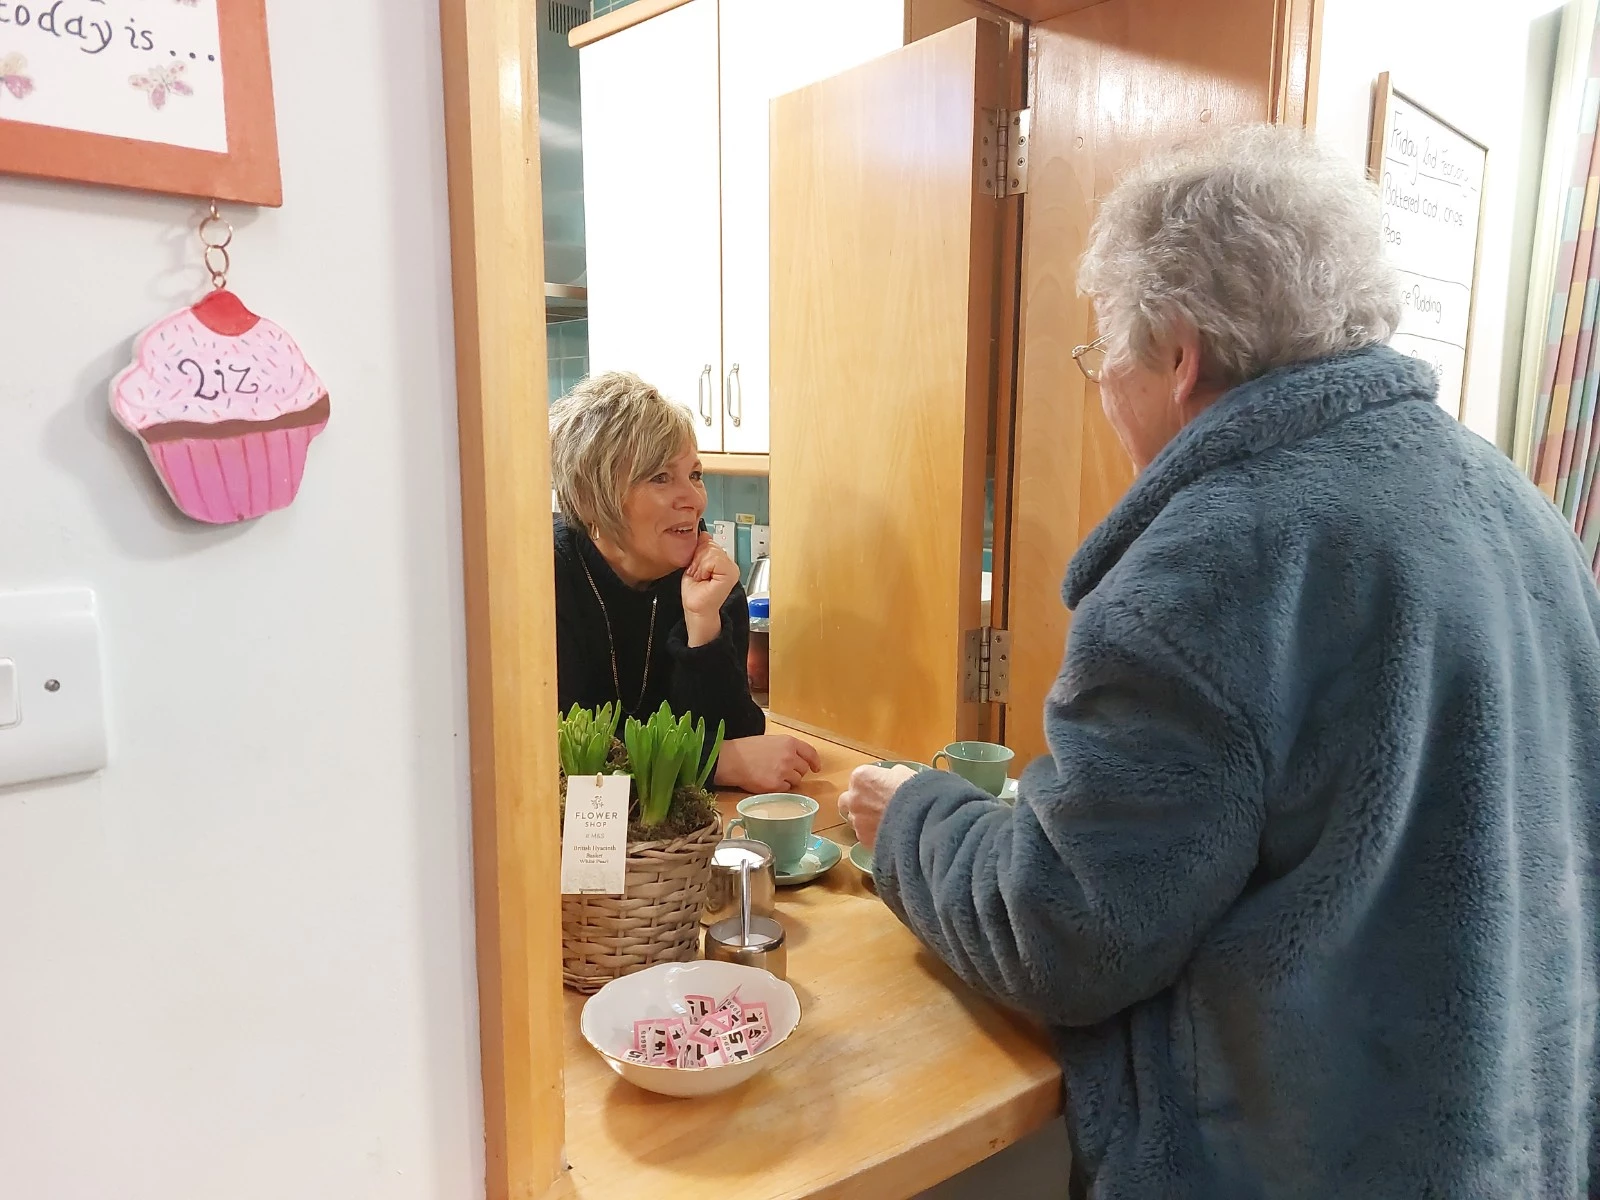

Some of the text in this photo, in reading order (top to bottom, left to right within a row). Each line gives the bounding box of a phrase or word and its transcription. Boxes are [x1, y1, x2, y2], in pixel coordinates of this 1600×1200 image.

[1390, 110, 1418, 186] Friday
[1412, 284, 1442, 324] Pudding
[575, 811, 618, 820] FLOWER
